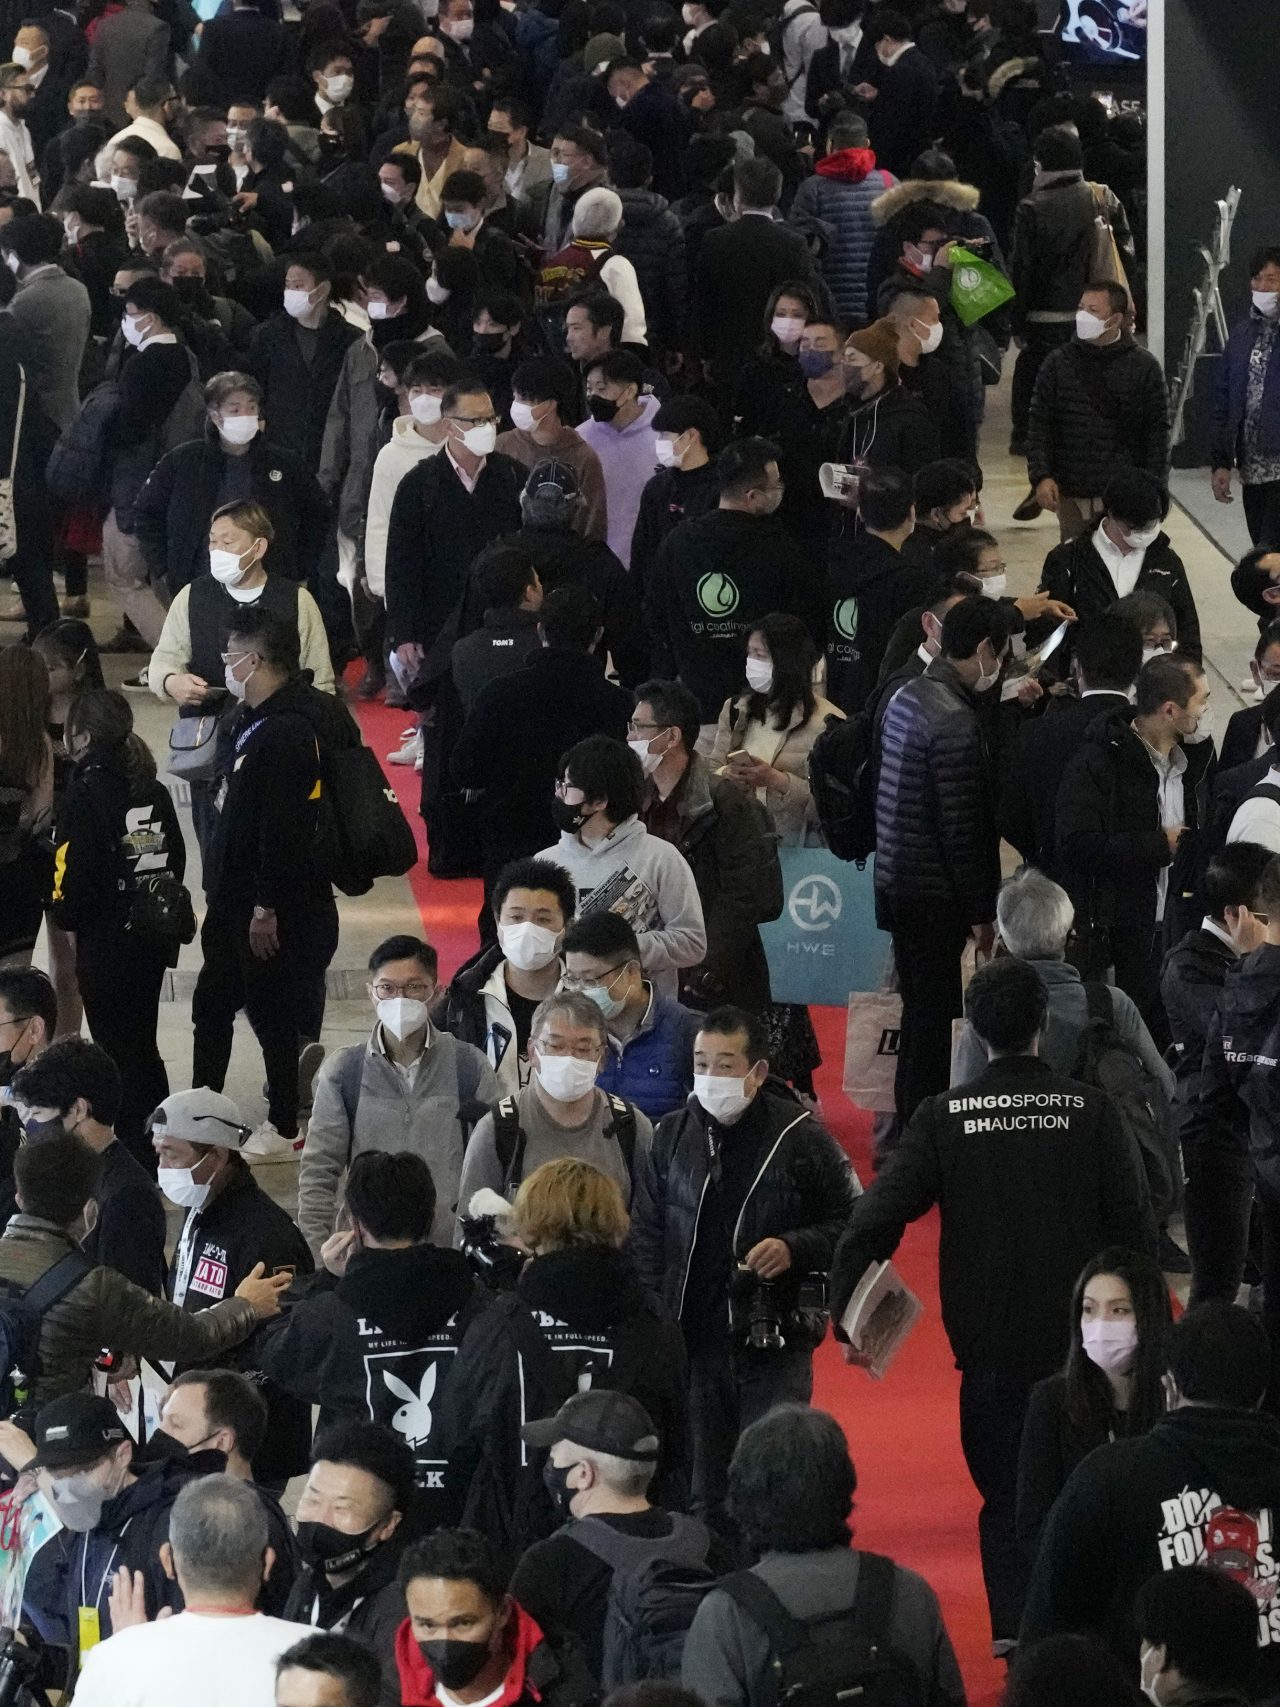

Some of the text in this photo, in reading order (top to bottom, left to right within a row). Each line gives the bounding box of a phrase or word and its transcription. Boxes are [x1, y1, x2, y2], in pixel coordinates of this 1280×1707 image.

[787, 942, 836, 956] HWE
[948, 1093, 1085, 1114] BINGOSPORTS
[963, 1115, 1069, 1135] BHAUCTION
